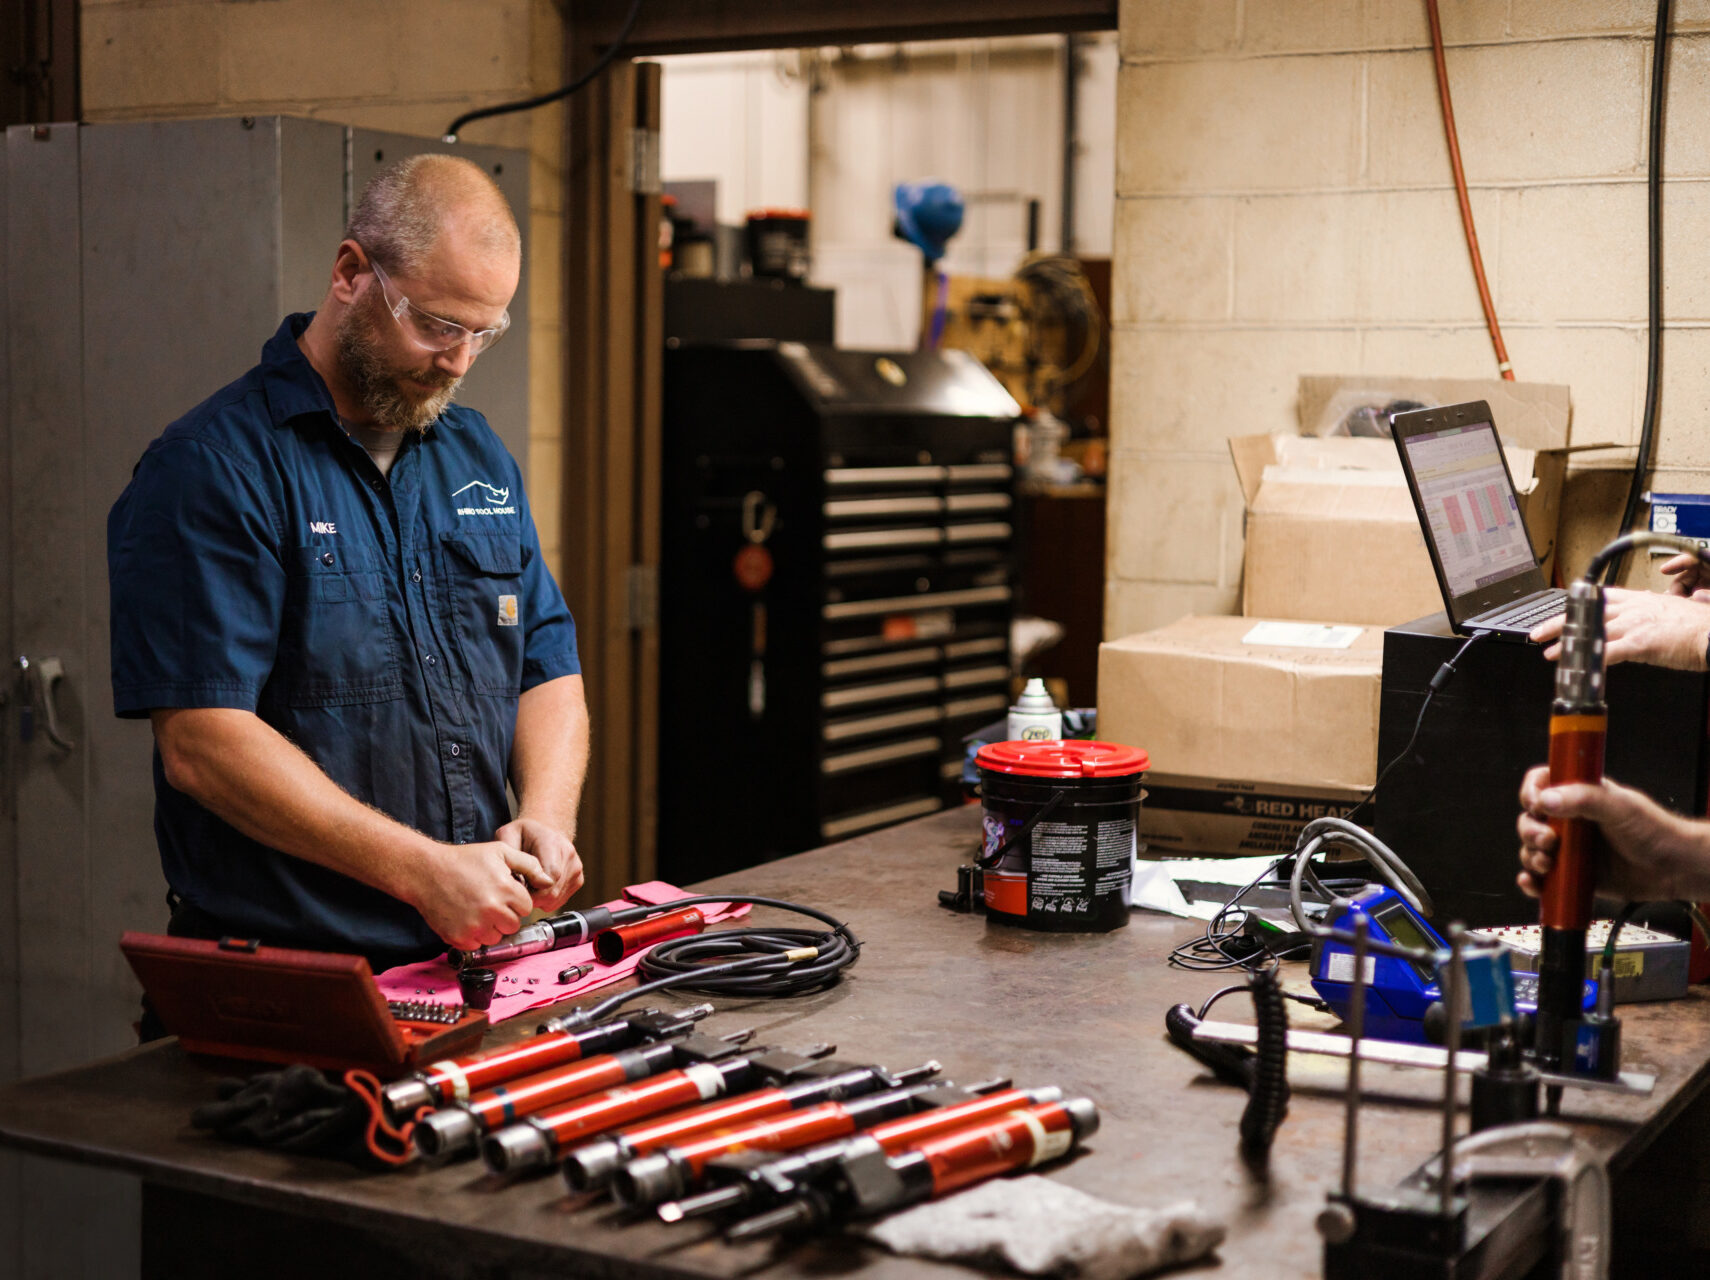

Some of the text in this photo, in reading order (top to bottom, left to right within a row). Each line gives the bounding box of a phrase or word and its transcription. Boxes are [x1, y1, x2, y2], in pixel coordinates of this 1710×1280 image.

[475, 507, 494, 515] TOOL
[493, 506, 516, 515] HOUSE
[310, 521, 337, 534] MIKE
[1256, 800, 1354, 821] RED HEAD
